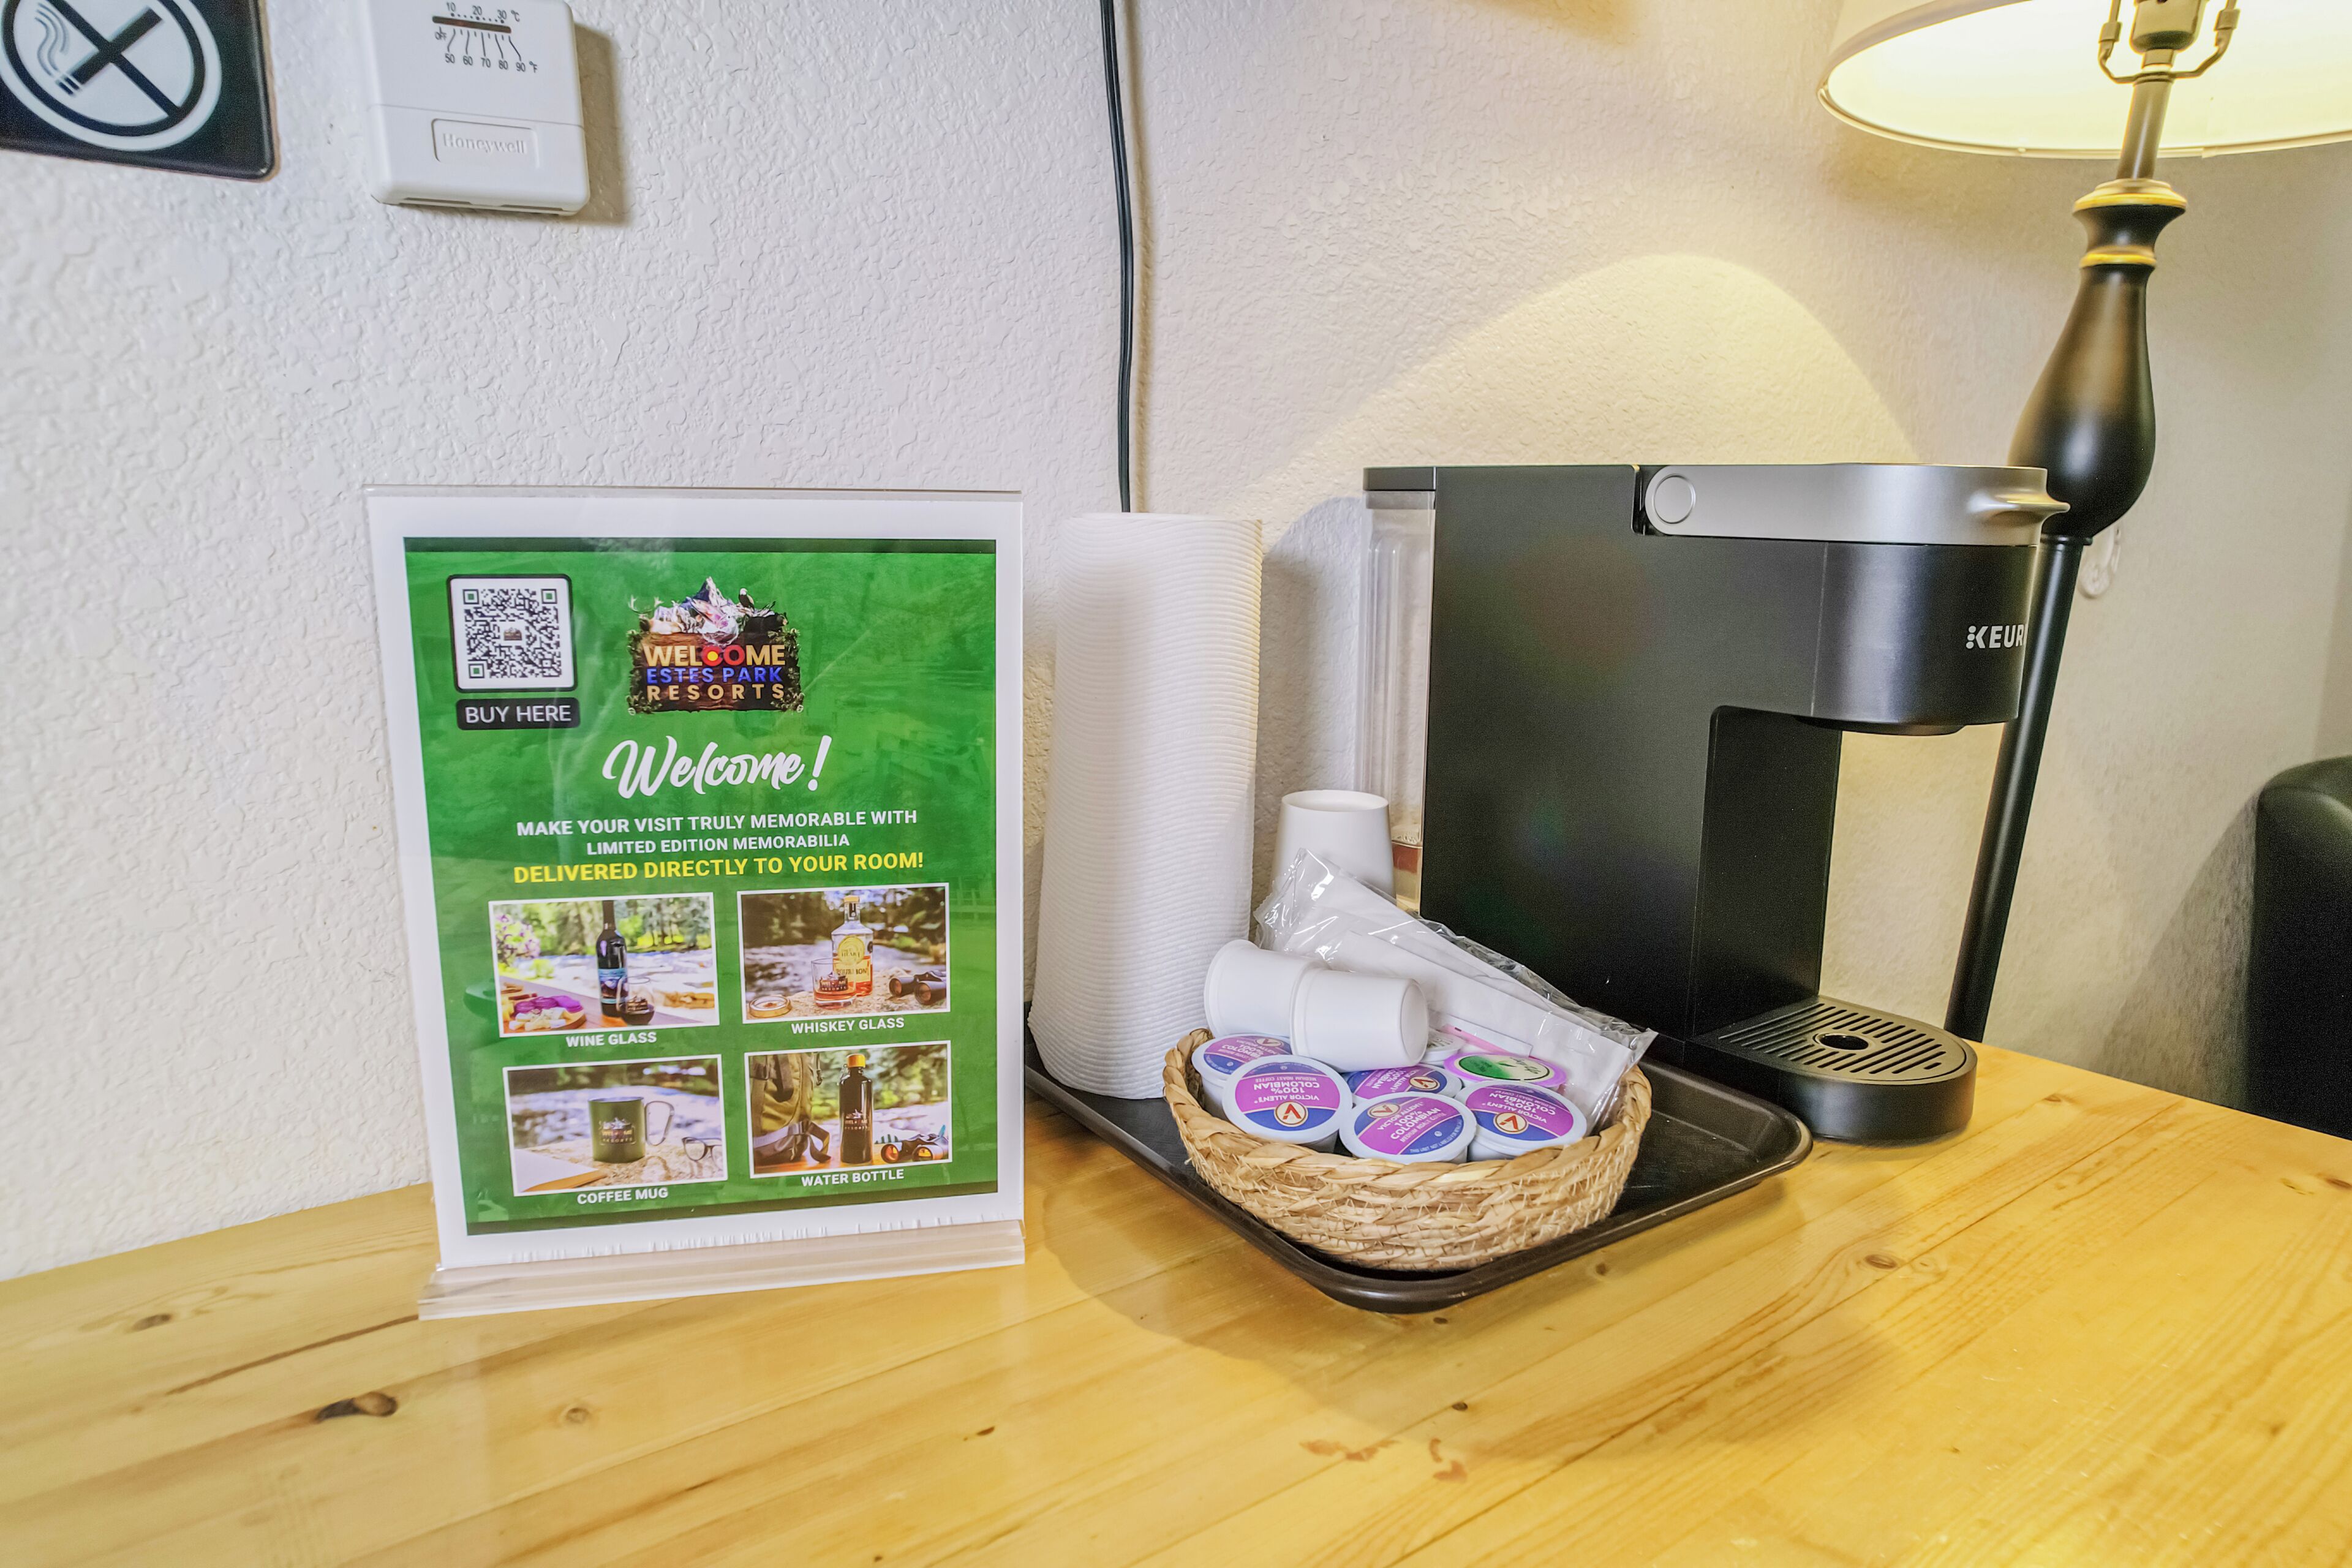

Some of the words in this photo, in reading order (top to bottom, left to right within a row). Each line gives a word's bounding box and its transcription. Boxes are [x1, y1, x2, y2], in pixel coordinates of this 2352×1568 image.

[447, 2, 456, 12] 10
[472, 6, 482, 16] 20
[497, 9, 507, 20] 30
[445, 53, 455, 64] 50
[463, 56, 473, 66] 60
[481, 58, 491, 68] 70
[499, 60, 508, 70] 80
[516, 62, 526, 72] 90
[443, 132, 527, 154] Honeywell
[1966, 624, 2029, 649] KEURI
[643, 644, 786, 667] WELCOME
[647, 666, 714, 684] ESTES
[723, 666, 783, 683] PARK
[647, 683, 785, 701] RESORTS
[465, 706, 510, 724] BUY
[516, 704, 572, 723] HERE
[602, 735, 832, 799] Welcome!
[516, 820, 573, 836] MAKE
[577, 818, 630, 834] YOUR
[634, 816, 684, 832] VISIT
[687, 815, 745, 830] TRULY
[750, 812, 867, 828] MEMORABLE
[870, 810, 918, 824] WITH
[586, 840, 656, 855] LIMITED
[660, 837, 728, 853] EDITION
[733, 834, 850, 850] MEMORABILIA
[513, 862, 638, 883] DELIVERED
[643, 858, 748, 878] DIRECTLY
[753, 857, 783, 874] TO
[788, 855, 847, 872] YOUR
[853, 852, 923, 870] ROOM!
[791, 1020, 855, 1034] WHISKEY
[859, 1017, 905, 1030] GLASS
[565, 1034, 605, 1047] WINE
[608, 1031, 657, 1045] GLASS
[1253, 1081, 1320, 1090] COLOMBIAN
[1489, 1093, 1556, 1115] COLOMBIAN
[1504, 1099, 1537, 1114] 100%
[1376, 1113, 1402, 1131] VICTOR
[1390, 1107, 1441, 1140] COLOMBIAN
[1394, 1110, 1423, 1126] 100%
[1517, 1109, 1547, 1123] VICTOR
[1400, 1128, 1418, 1143] MEDIUM
[801, 1173, 849, 1186] WATER
[852, 1169, 904, 1183] BOTTLE
[577, 1189, 632, 1205] COFFEE
[635, 1187, 668, 1200] MUG
